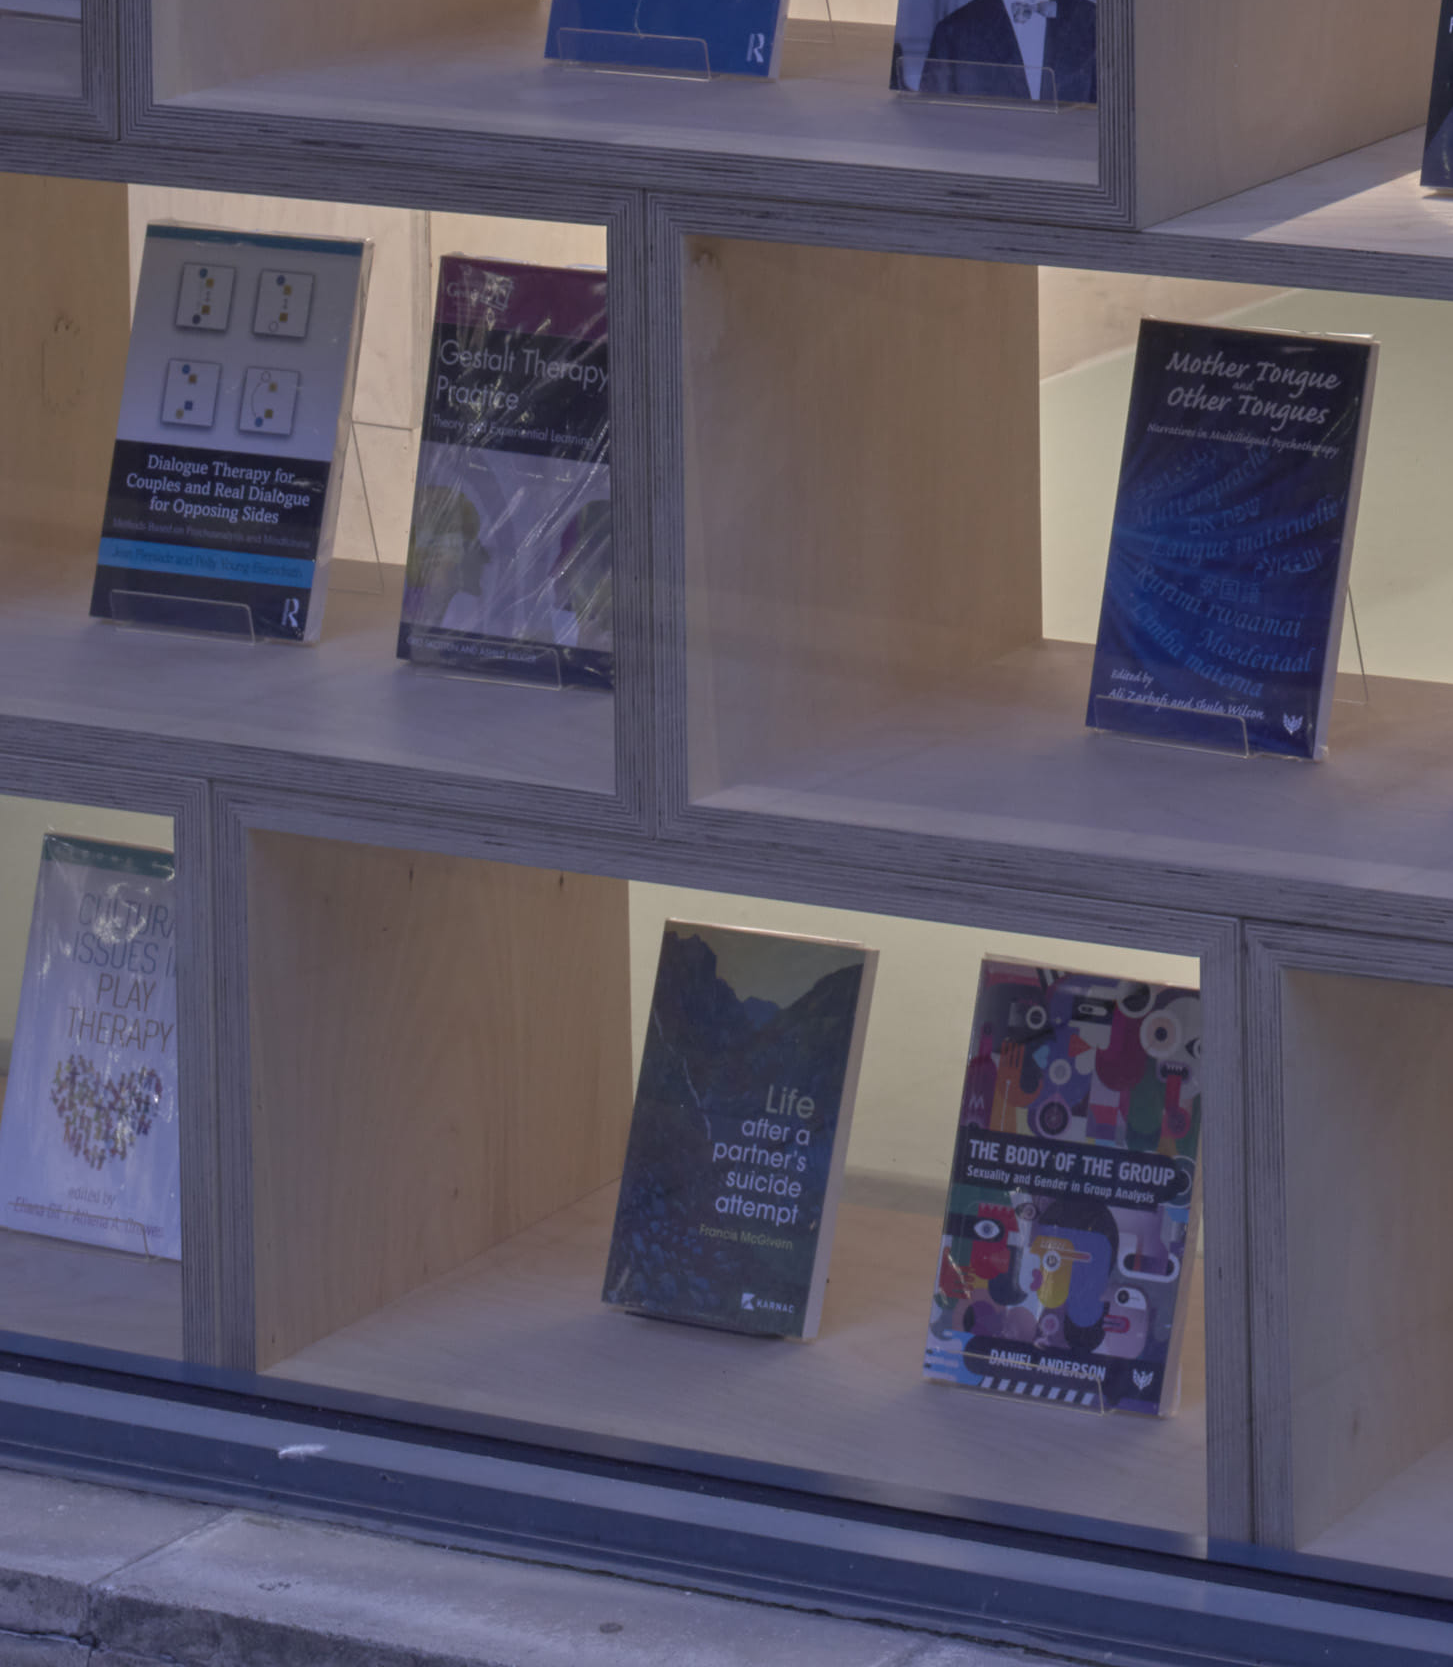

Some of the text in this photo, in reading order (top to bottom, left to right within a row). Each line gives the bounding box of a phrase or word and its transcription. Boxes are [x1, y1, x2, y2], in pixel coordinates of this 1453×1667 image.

[440, 339, 516, 373] Gestalt
[1166, 352, 1341, 399] Mother Tongue
[1233, 380, 1254, 391] and
[437, 375, 519, 410] Practice
[1167, 384, 1330, 432] Other Tongues
[489, 422, 548, 441] Experiential
[147, 454, 294, 485] Dialogue Therapy for
[127, 473, 310, 508] Couples and Real Dialogue
[149, 496, 279, 524] for Opposing Sides
[72, 931, 159, 974] ISSUES
[96, 973, 157, 1013] PLAY
[67, 1007, 174, 1054] THERAPY
[765, 1084, 815, 1119] Life
[741, 1119, 810, 1146] after a
[712, 1142, 807, 1172] partner's
[969, 1139, 1176, 1187] THE BODY OF THE GROUP
[725, 1171, 802, 1198] suicide
[967, 1165, 1155, 1204] Sexuality and Gender in Group Analysis
[715, 1195, 798, 1227] attempt
[699, 1223, 738, 1241] Francis
[756, 1299, 795, 1314] KARNAC
[988, 1349, 1107, 1382] DANIEL ANDERSON
